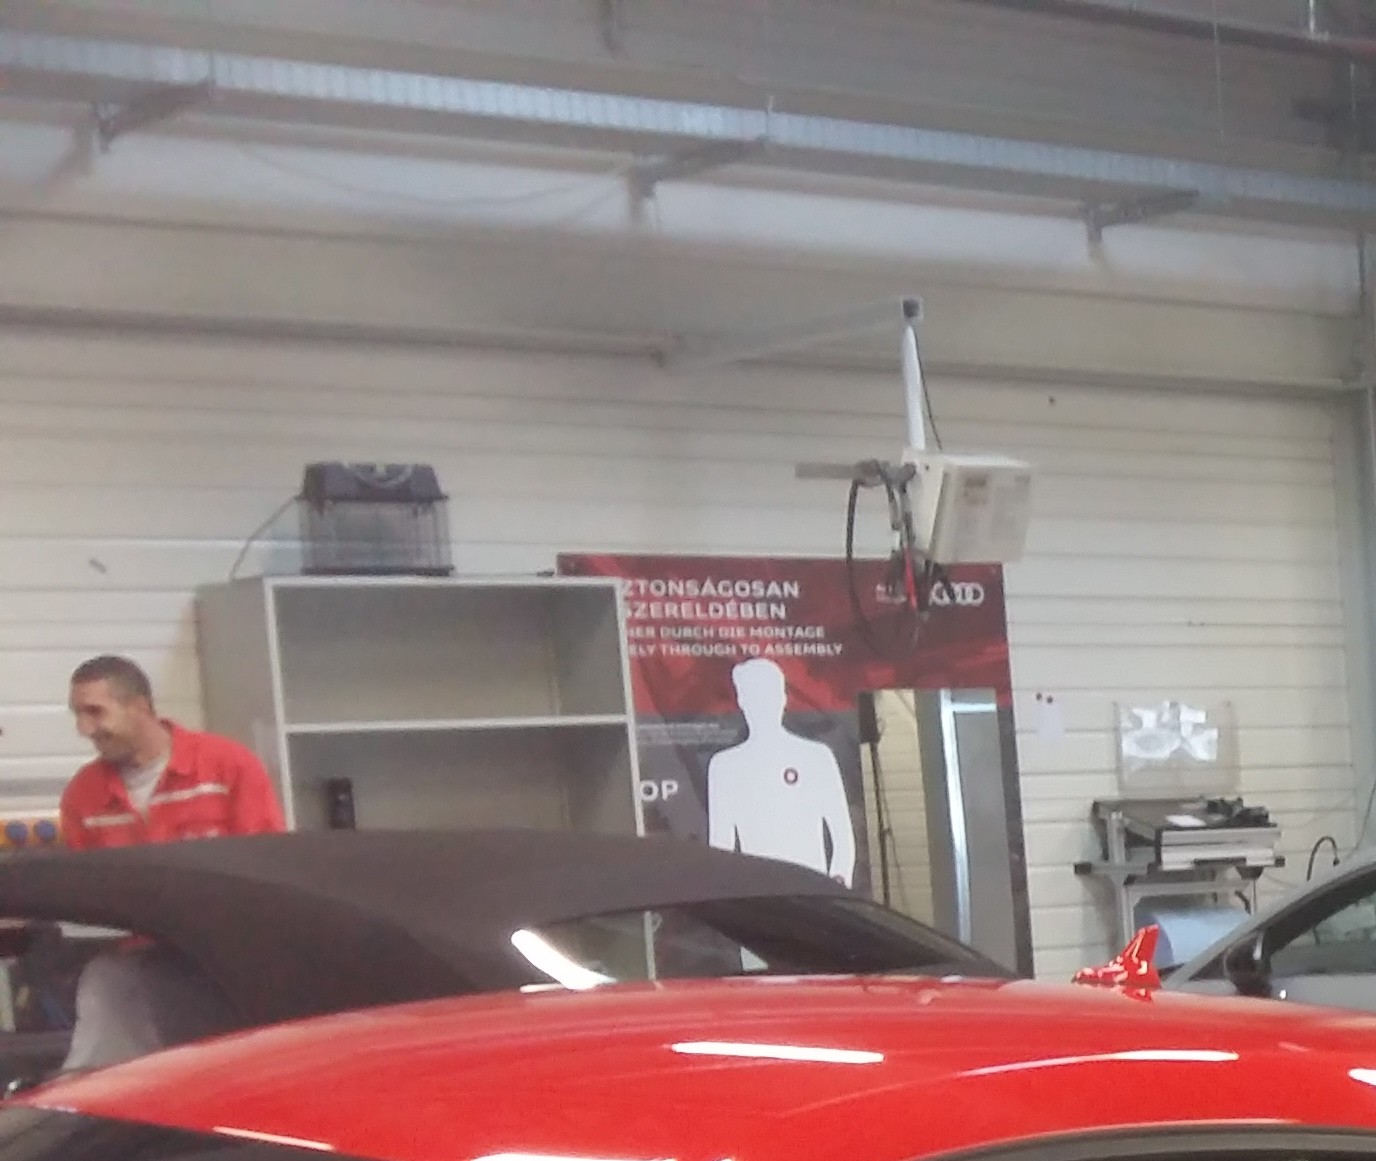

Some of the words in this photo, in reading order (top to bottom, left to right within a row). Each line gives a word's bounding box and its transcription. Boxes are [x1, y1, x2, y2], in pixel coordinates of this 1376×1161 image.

[749, 625, 825, 640] MONTAGE
[661, 643, 737, 657] THROUGH
[740, 643, 760, 656] TO
[764, 642, 844, 656] ASSEMBLY
